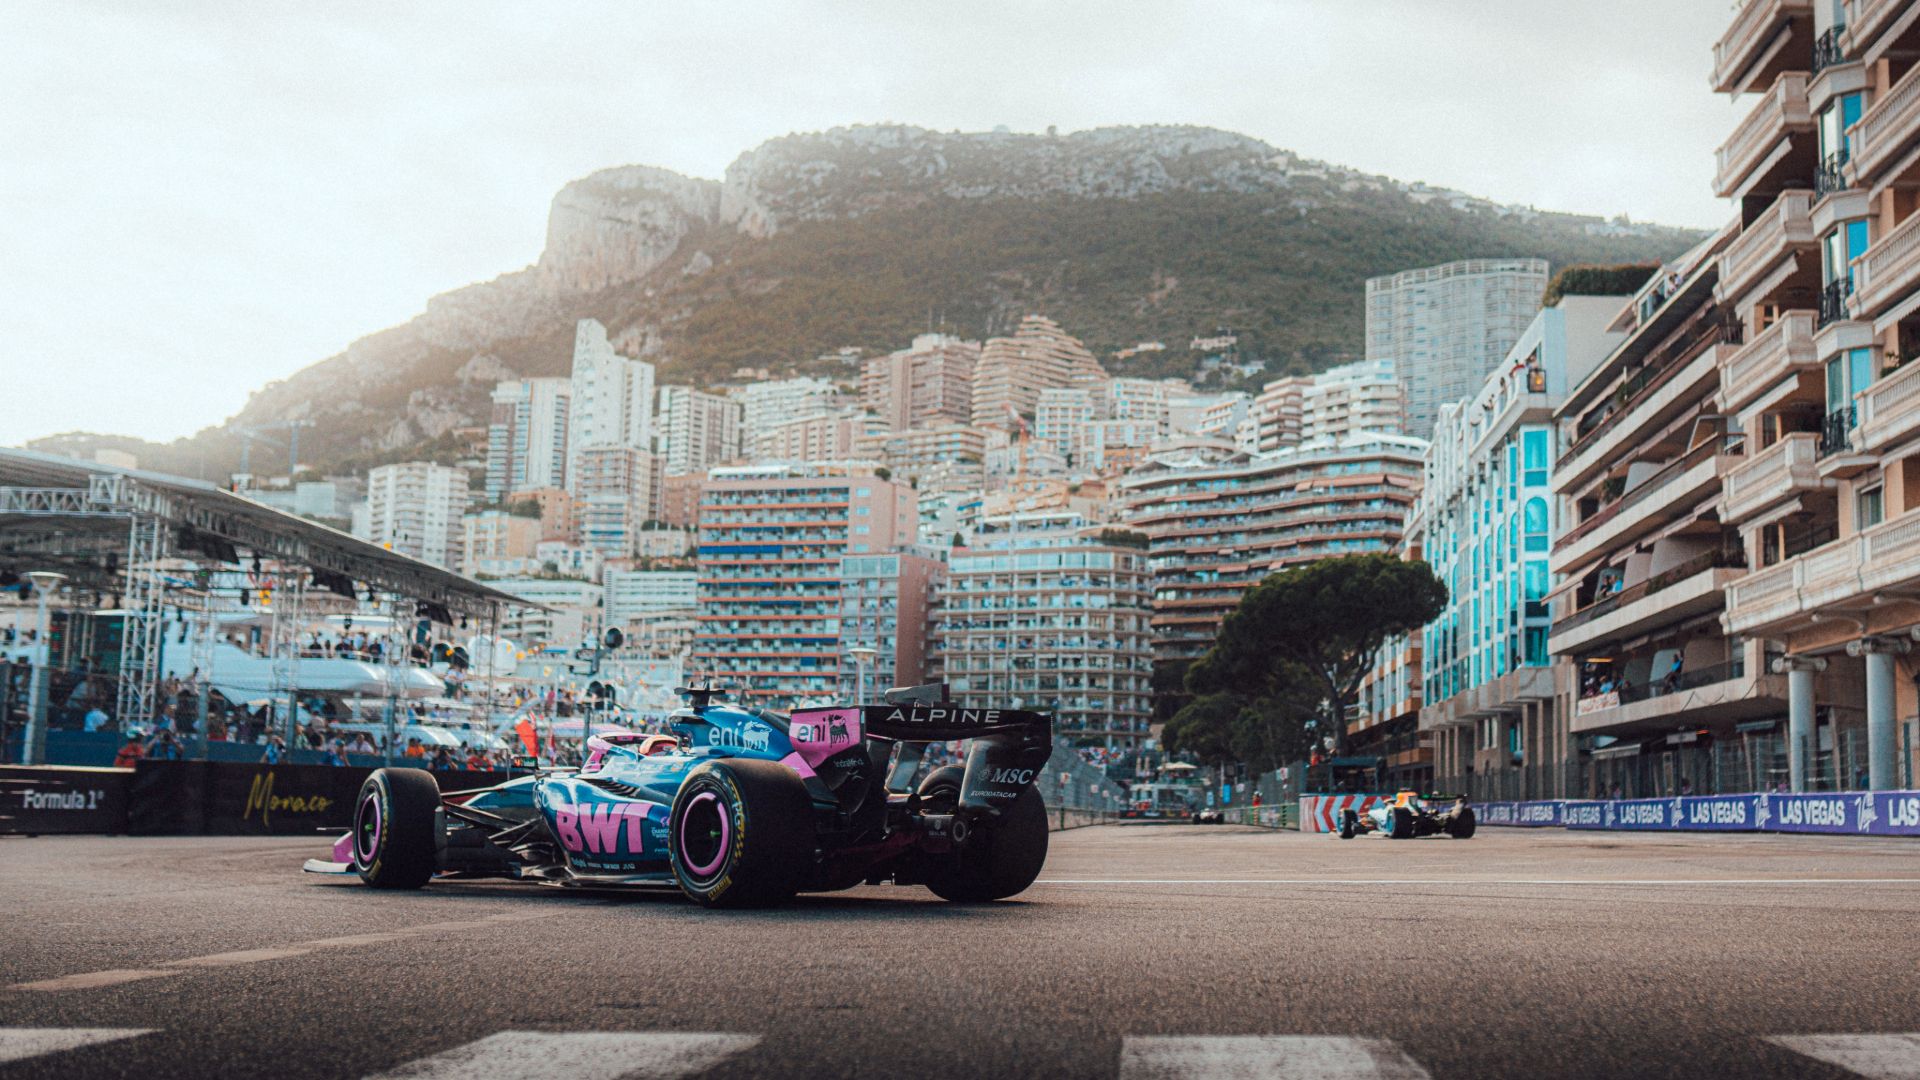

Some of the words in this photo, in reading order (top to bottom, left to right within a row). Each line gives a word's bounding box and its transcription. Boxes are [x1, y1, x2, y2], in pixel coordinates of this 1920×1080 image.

[886, 703, 1001, 723] ALPINE
[708, 720, 742, 747] eni
[797, 717, 826, 743] eni
[990, 768, 1034, 785] MSC
[23, 788, 86, 809] Formula
[244, 771, 334, 828] Monaco
[1620, 804, 1635, 824] LAS
[1636, 804, 1664, 824] VEGAS
[1690, 802, 1710, 824] LAS
[1711, 801, 1746, 824] VEGAS
[1779, 800, 1802, 825] LAS
[1803, 800, 1846, 826] VEGAS
[1888, 798, 1920, 827] LAS
[556, 803, 654, 854] BWT
